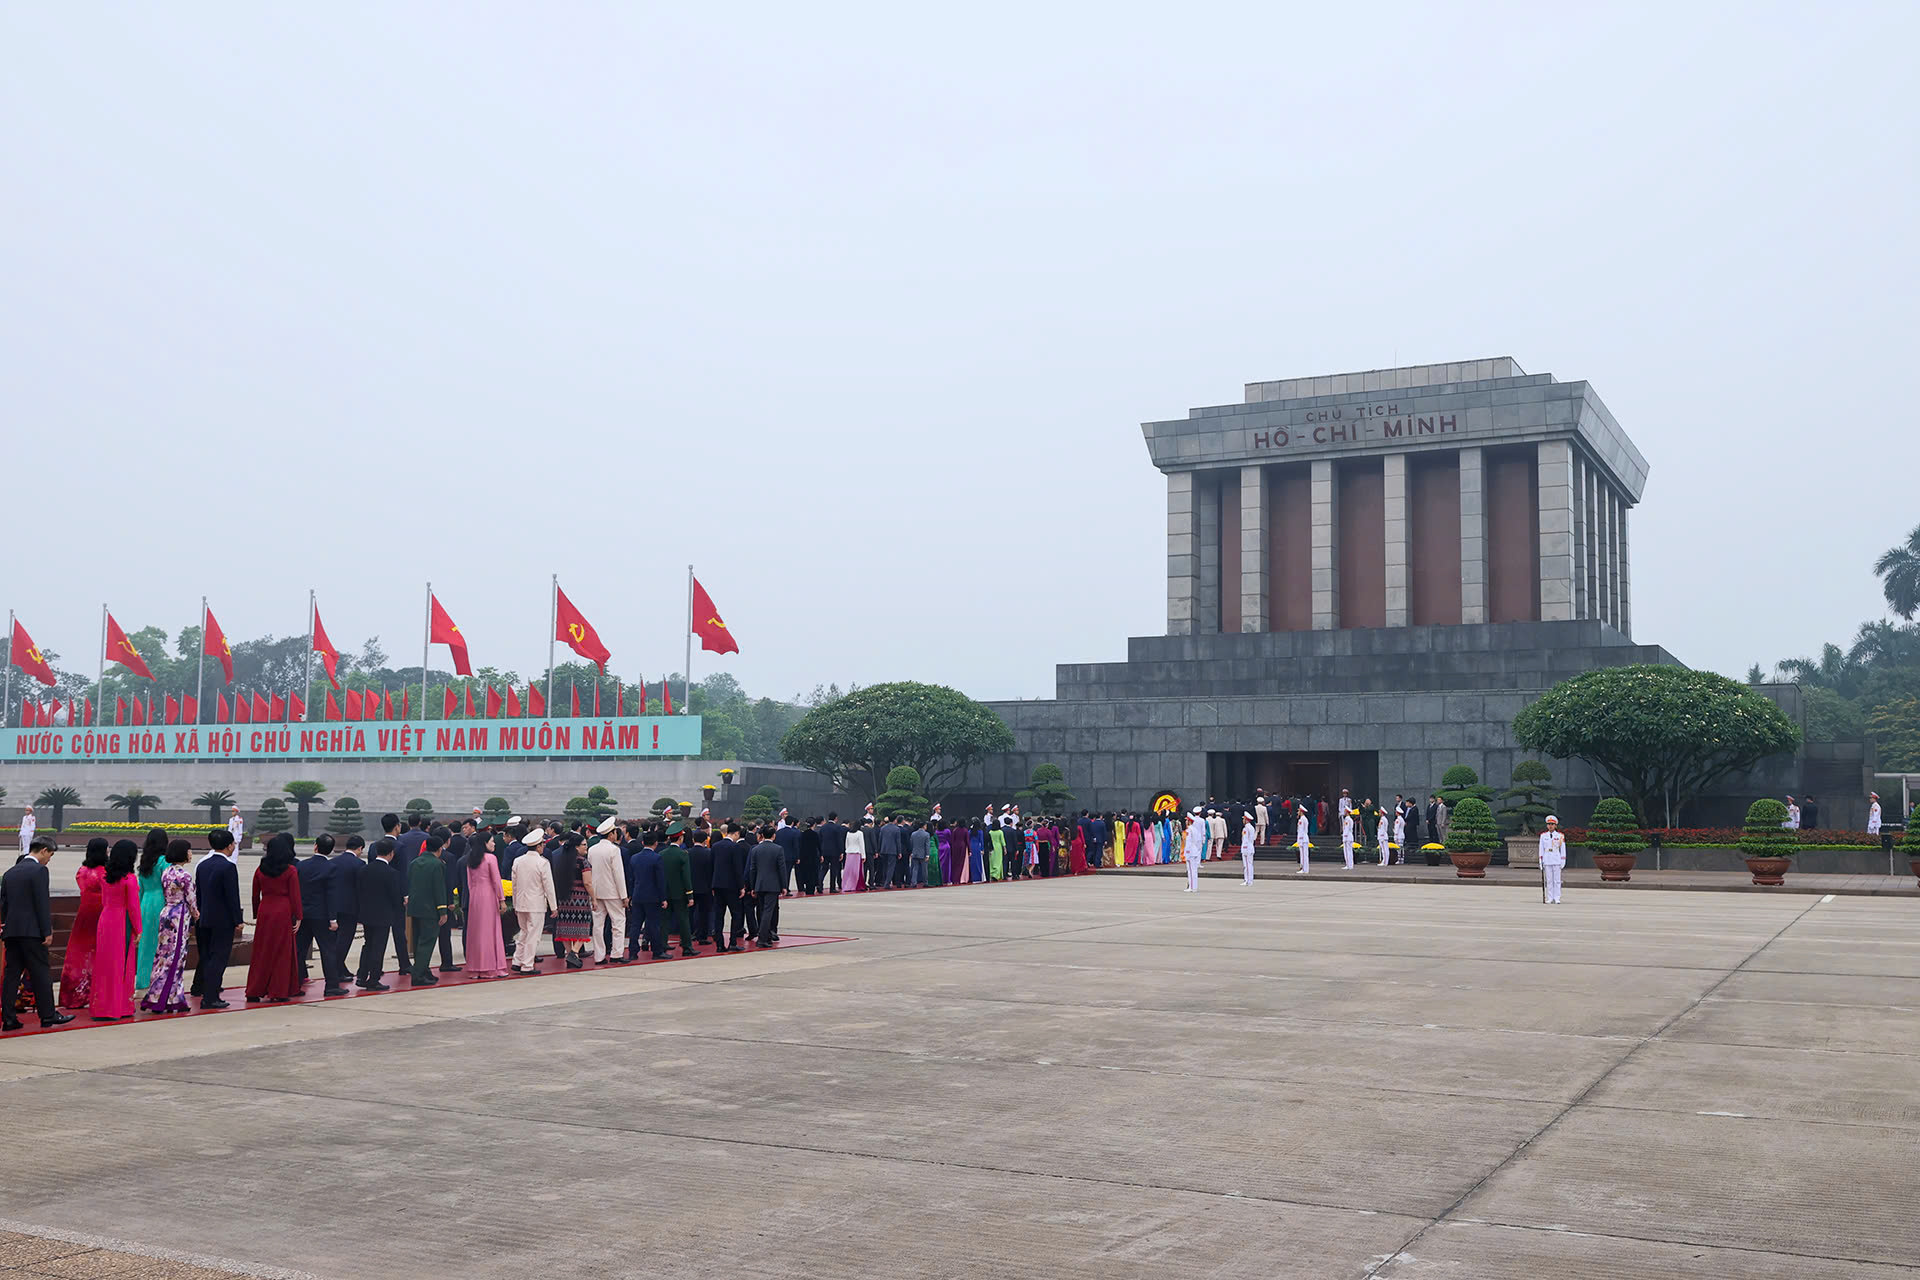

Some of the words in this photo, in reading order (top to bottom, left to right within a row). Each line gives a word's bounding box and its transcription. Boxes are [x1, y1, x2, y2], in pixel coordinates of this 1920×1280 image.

[1356, 403, 1398, 421] TỊCH
[16, 729, 63, 754] NƯỚC
[71, 729, 120, 757] CỘNG
[128, 729, 166, 754] HÒA
[174, 728, 199, 754] XÃ
[208, 727, 241, 757] HỘI
[251, 724, 291, 753] CHỦ
[300, 725, 366, 753] NGHĨA
[378, 724, 426, 756] VIỆT
[436, 726, 488, 751] NAM
[499, 721, 570, 750] MUÔN
[582, 720, 640, 750] NĂM
